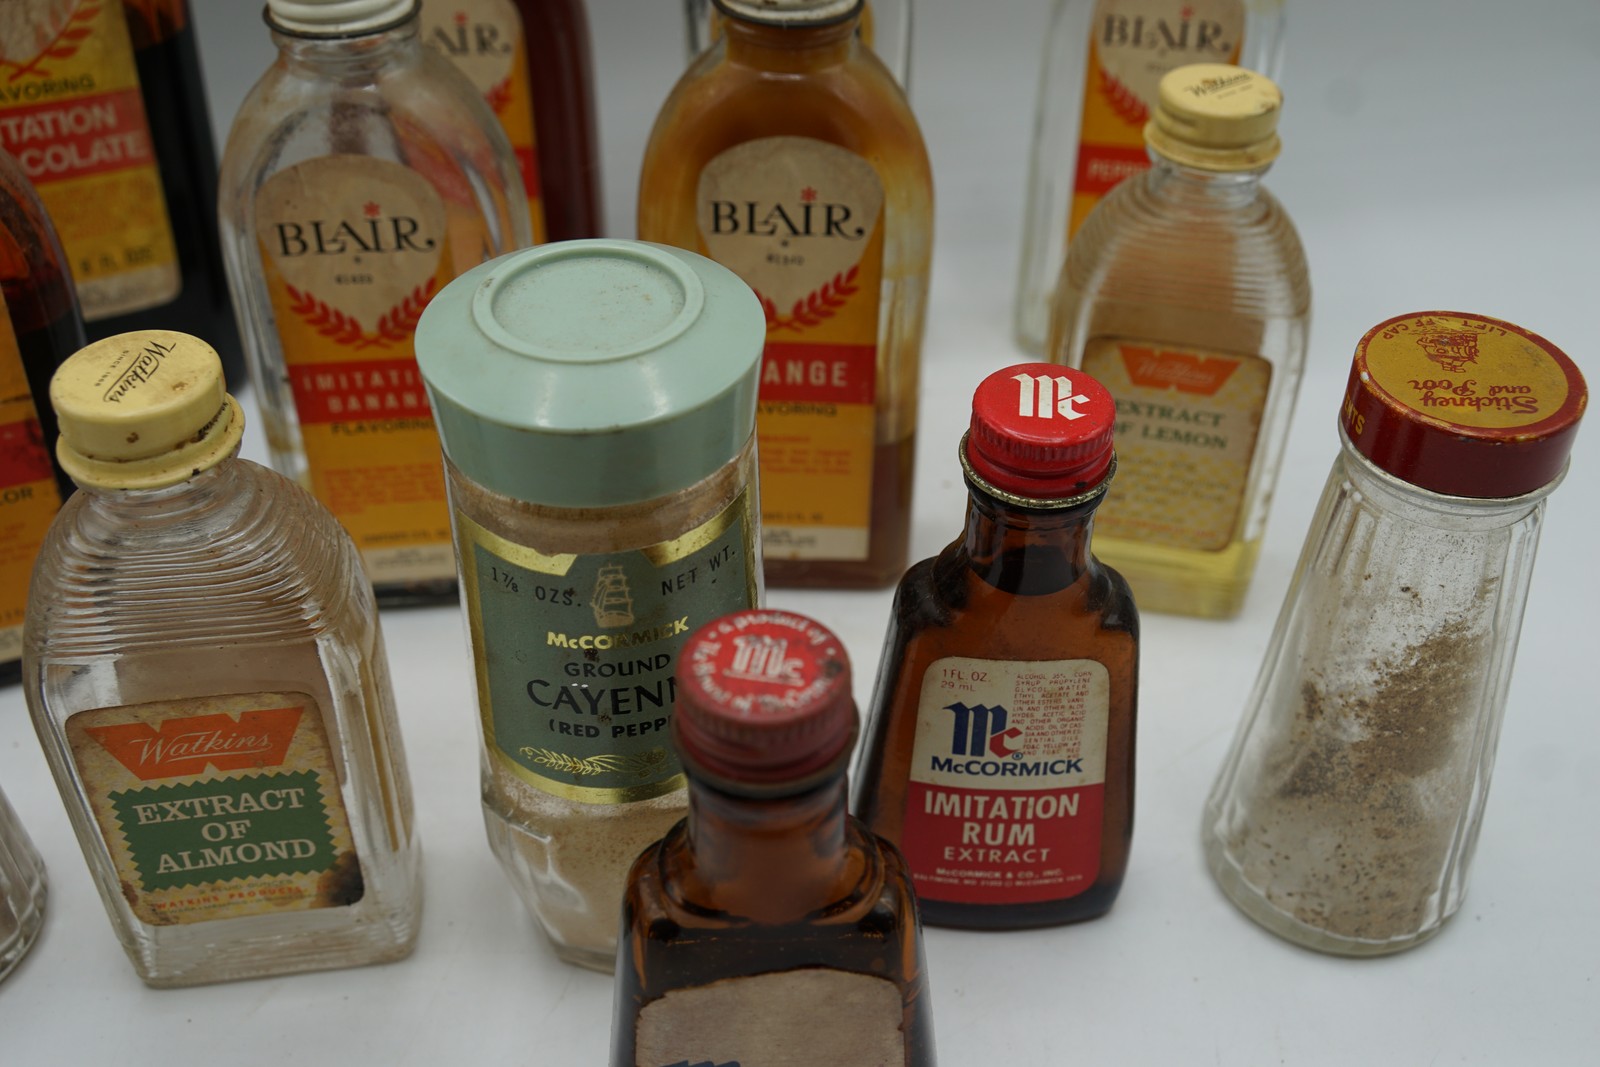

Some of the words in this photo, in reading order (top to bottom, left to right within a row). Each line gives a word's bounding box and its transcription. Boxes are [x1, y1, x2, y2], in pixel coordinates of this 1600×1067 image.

[0, 104, 118, 147] TATION
[20, 136, 147, 177] COLATE
[1382, 323, 1409, 340] CAP
[1462, 320, 1507, 336] LIFT
[103, 340, 177, 403] Watkins
[303, 369, 427, 391] IMITATI
[1407, 379, 1477, 396] Poor
[1489, 385, 1532, 396] and
[1115, 399, 1226, 427] EXTRACT
[1418, 390, 1539, 414] Stickney
[1142, 424, 1229, 449] LEMON
[661, 567, 698, 596] NET
[709, 545, 736, 572] WT.
[535, 585, 582, 608] OZS.
[546, 616, 689, 650] McCORMICK
[563, 653, 672, 678] GROUND
[942, 668, 948, 678] 1
[940, 680, 955, 689] 29
[549, 718, 600, 738] (RED
[611, 716, 671, 739] PEPP
[128, 730, 274, 767] Watkins
[931, 755, 1083, 777] McCORMICK
[132, 787, 305, 825] EXTRACT
[924, 790, 1080, 820] IMITATION
[202, 819, 251, 842] OF
[962, 821, 1035, 846] RUM
[156, 838, 317, 874] ALMOND
[943, 846, 1051, 863] EXTRACT
[936, 868, 1001, 878] McCORMICK
[156, 895, 220, 910] WATKINS
